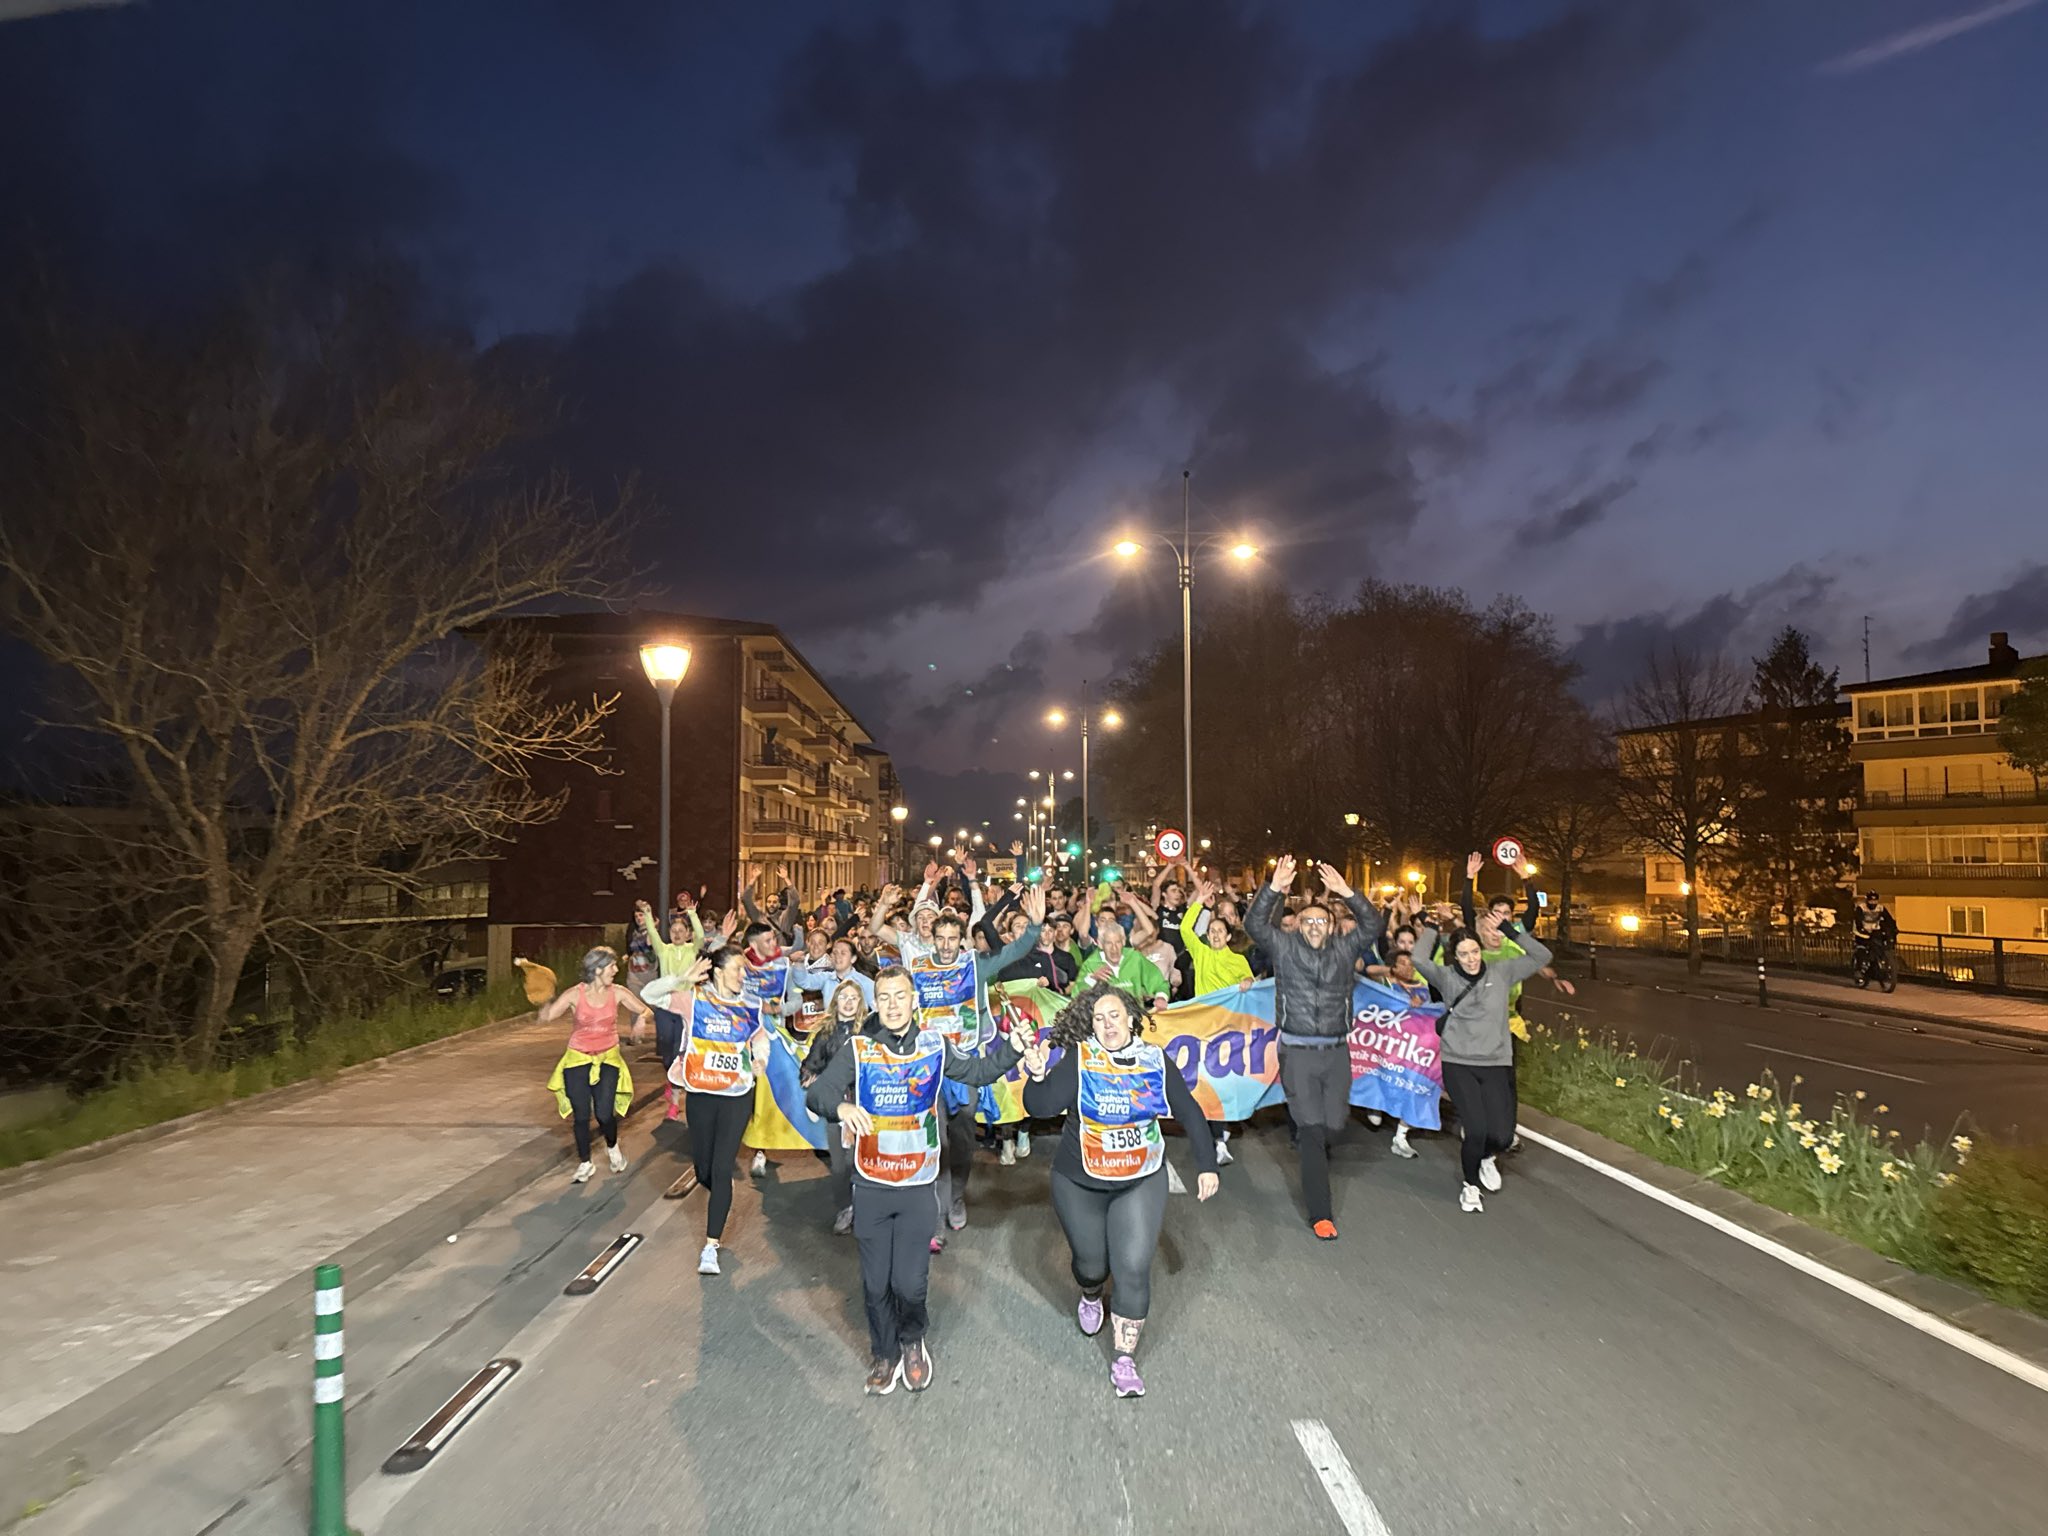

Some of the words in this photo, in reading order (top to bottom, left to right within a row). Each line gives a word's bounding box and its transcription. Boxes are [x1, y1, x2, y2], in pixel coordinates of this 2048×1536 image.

[1162, 839, 1180, 851] 30
[1500, 847, 1518, 859] 30
[923, 991, 944, 1002] gara
[804, 1004, 816, 1013] 16
[1357, 1004, 1412, 1034] aek
[705, 1023, 732, 1034] gara
[1346, 1019, 1436, 1068] korrika
[711, 1053, 739, 1071] 1588
[1164, 1025, 1280, 1092] gar
[870, 1084, 909, 1095] Euskara
[874, 1093, 909, 1108] gara
[1097, 1102, 1130, 1117] gara
[1109, 1126, 1142, 1149] 1588
